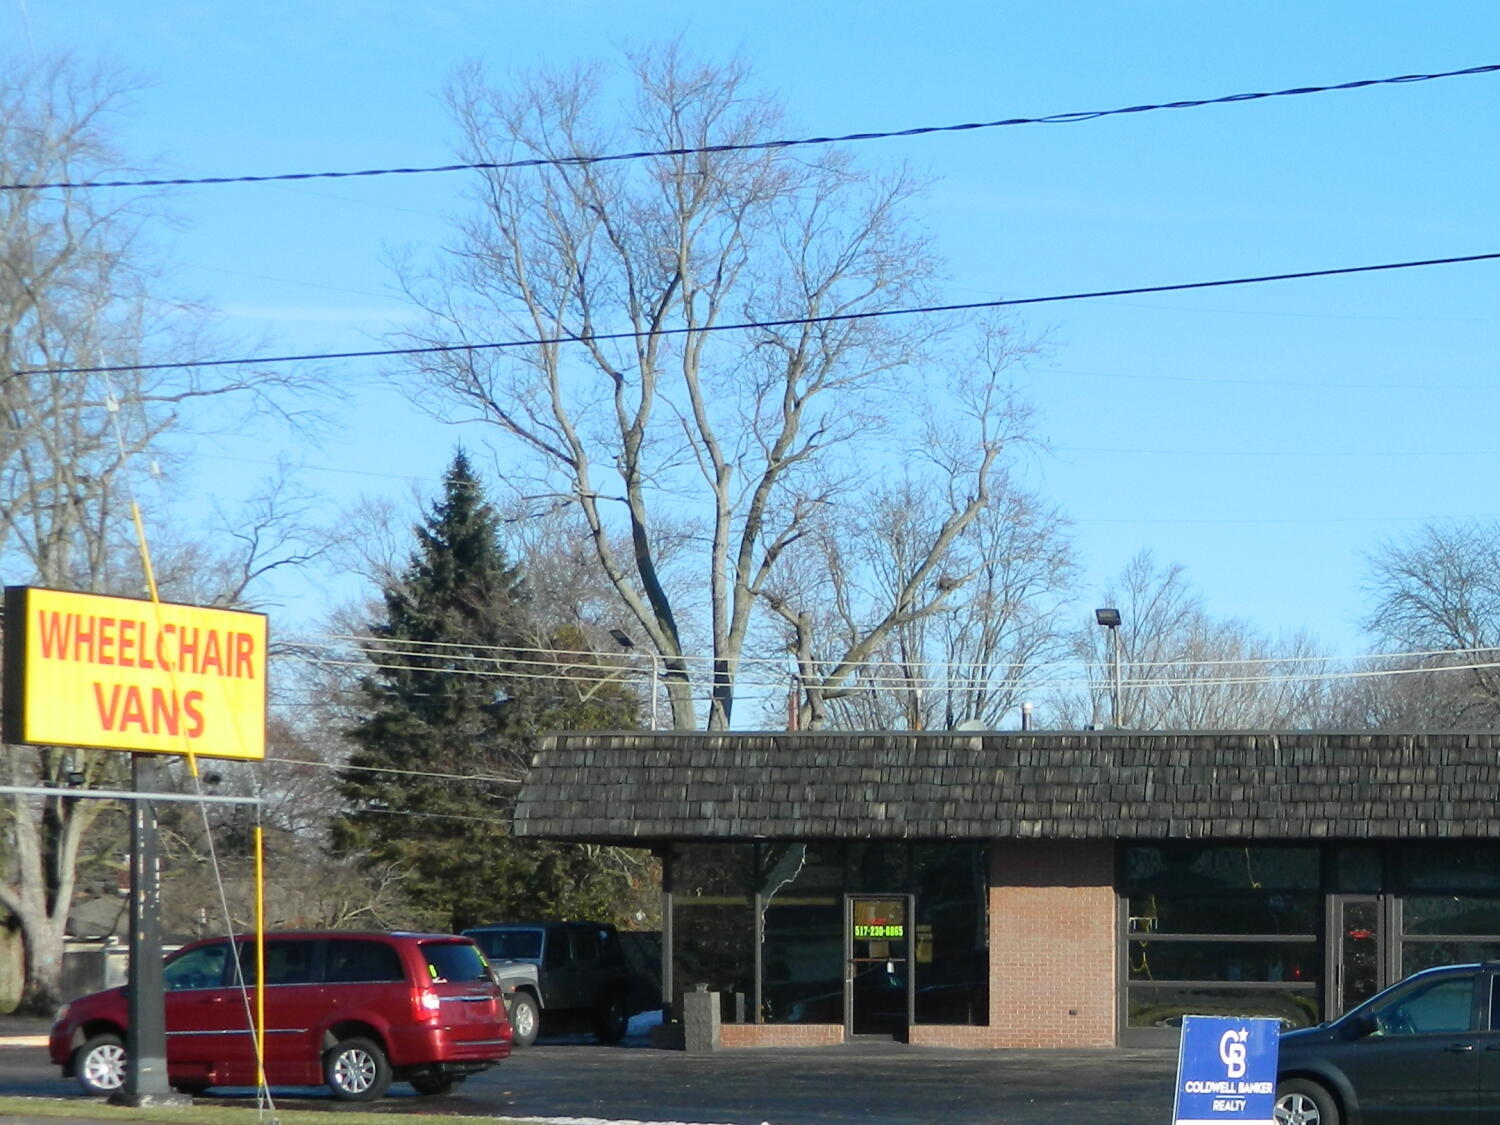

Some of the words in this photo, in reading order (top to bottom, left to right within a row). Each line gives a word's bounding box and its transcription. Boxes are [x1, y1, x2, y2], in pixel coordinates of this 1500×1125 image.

[39, 609, 255, 680] WHEELCHAIR
[93, 681, 206, 739] VANS
[1185, 1082, 1237, 1093] COLDWELL
[1238, 1082, 1273, 1094] BANKER
[1212, 1099, 1247, 1112] REALTY
